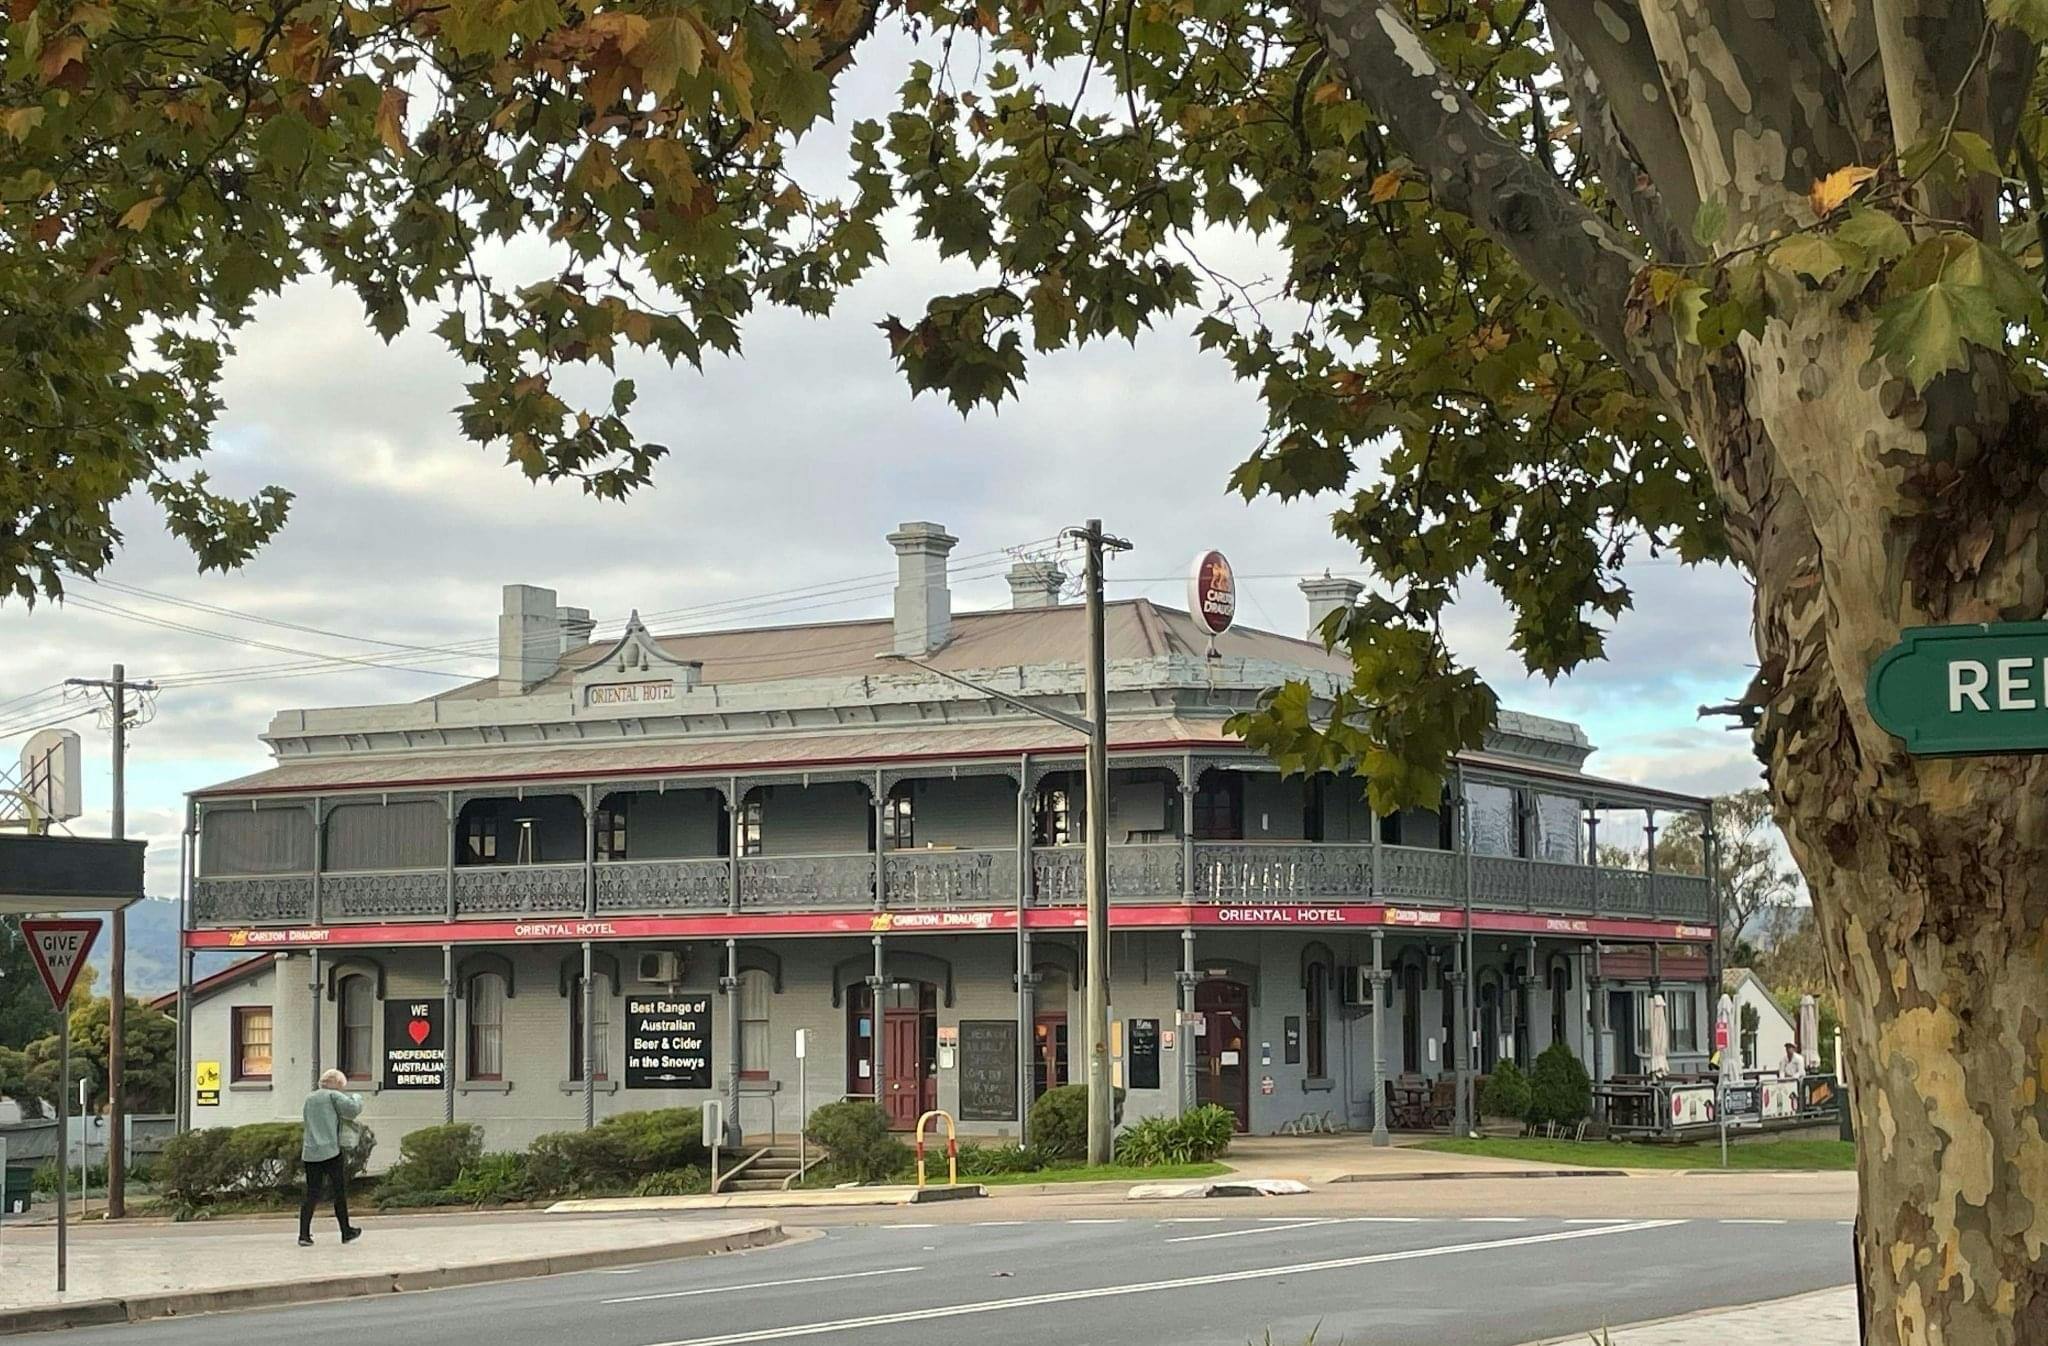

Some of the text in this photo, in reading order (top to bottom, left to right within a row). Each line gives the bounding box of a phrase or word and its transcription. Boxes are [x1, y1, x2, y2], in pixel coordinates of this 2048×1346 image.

[591, 683, 676, 704] ORIENTAL HOTEL
[892, 912, 993, 926] CARLTON DRAUGHT
[1218, 909, 1345, 921] ORIENTAL HOTEL
[248, 930, 330, 942] CARLTON DRAUGHT
[515, 923, 617, 936] ORIENTAL HOTEL
[43, 936, 78, 951] GIVE
[48, 955, 73, 967] WAY
[411, 1004, 429, 1016] WE
[630, 1001, 706, 1015] Best Range of
[640, 1019, 696, 1032] Australian
[634, 1037, 702, 1050] Beer & Cider
[388, 1049, 446, 1060] INDEPENDEN
[629, 1056, 705, 1070] in the Snowys
[397, 1074, 441, 1085] BREWERS
